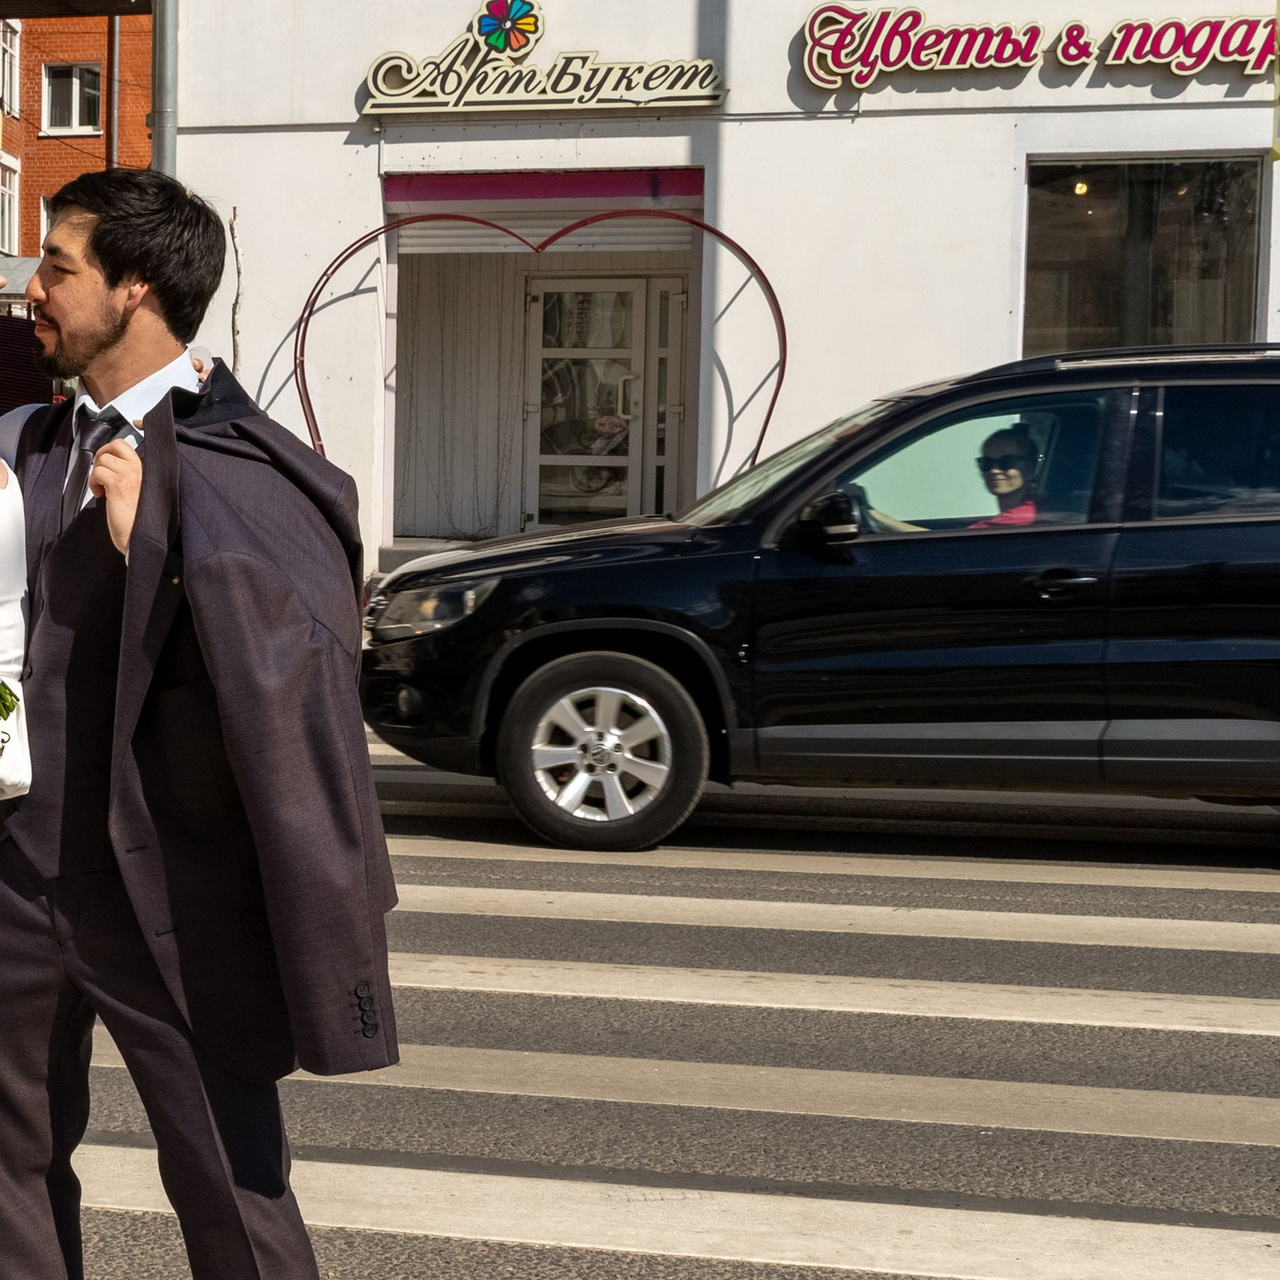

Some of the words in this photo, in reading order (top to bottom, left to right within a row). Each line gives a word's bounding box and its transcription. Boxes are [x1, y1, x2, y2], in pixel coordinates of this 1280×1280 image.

[372, 37, 544, 107] Арт
[551, 56, 718, 103] Букет
[808, 5, 1040, 85] Цветы
[1061, 25, 1093, 61] &
